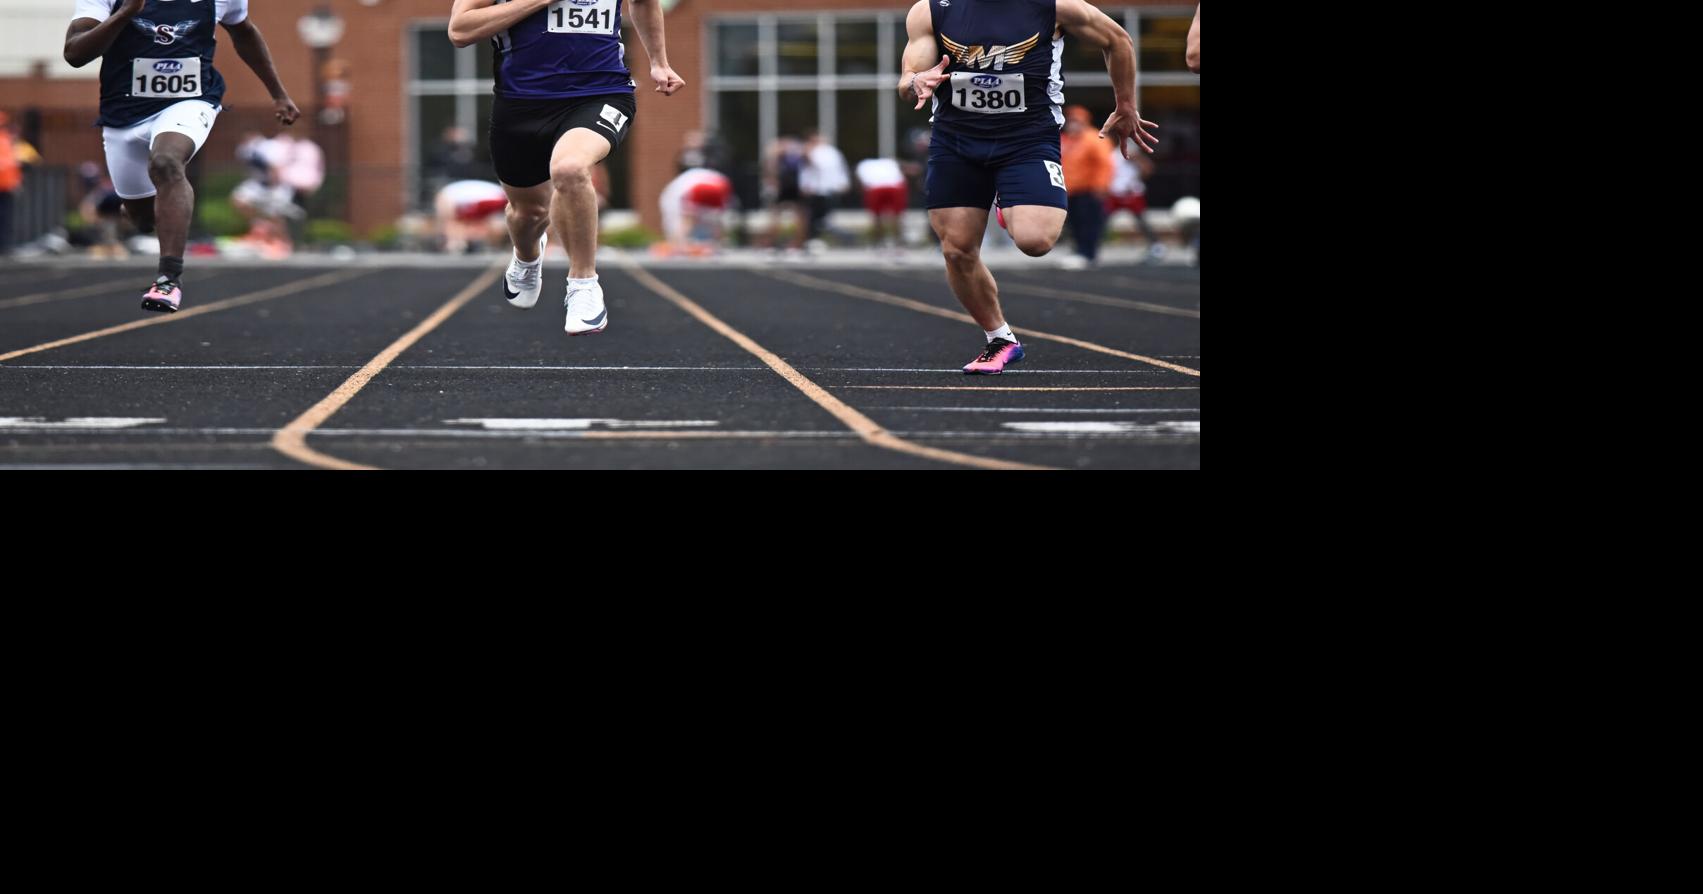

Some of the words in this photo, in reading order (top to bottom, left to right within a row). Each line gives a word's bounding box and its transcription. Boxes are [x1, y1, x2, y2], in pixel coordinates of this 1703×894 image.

[551, 7, 610, 29] 1541
[154, 24, 175, 45] S
[155, 62, 181, 70] PIAA
[135, 74, 197, 93] 1605
[973, 76, 1000, 85] PIAA
[955, 87, 1021, 109] 1380
[1049, 163, 1064, 186] 3
